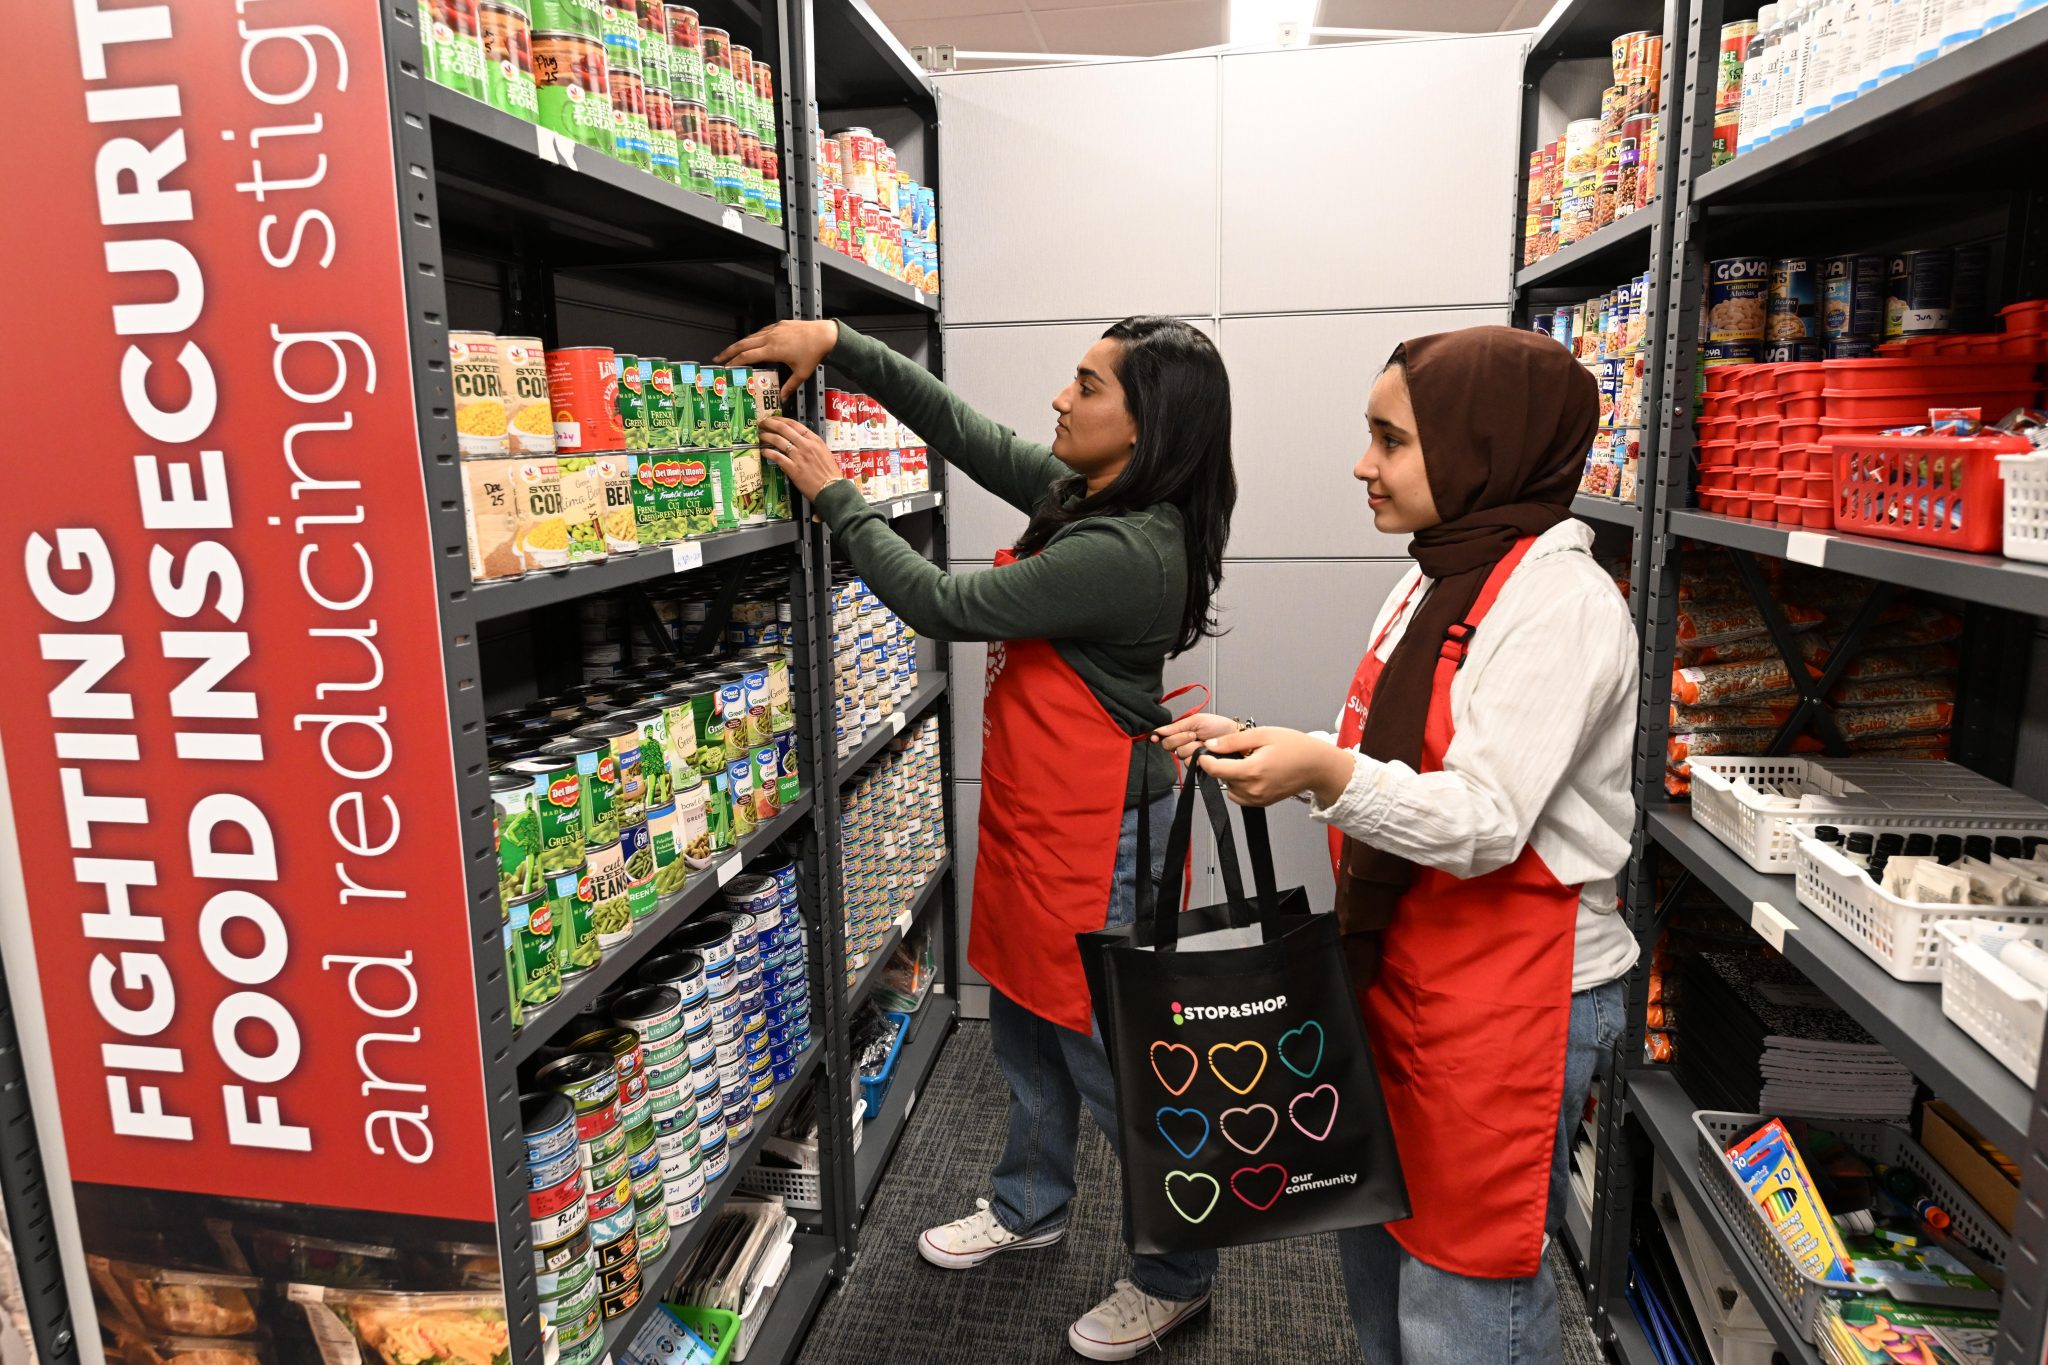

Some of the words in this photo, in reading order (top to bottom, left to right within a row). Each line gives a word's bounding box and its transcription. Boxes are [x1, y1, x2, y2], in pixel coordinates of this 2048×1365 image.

[1795, 80, 1804, 106] hand
[1717, 261, 1767, 280] GOYA
[655, 469, 666, 477] Del
[686, 468, 704, 477] Monte
[491, 494, 505, 507] 25
[667, 501, 681, 511] CUT
[686, 500, 701, 509] CUT
[267, 323, 407, 905] reducing
[752, 695, 768, 704] Green
[1847, 719, 1888, 734] Sarita
[552, 788, 564, 799] Del
[543, 809, 562, 817] MADE
[566, 822, 580, 834] CUT
[25, 528, 194, 1141] FIGHTING
[549, 836, 575, 848] GREEN
[603, 856, 623, 874] cut
[188, 793, 312, 1151] FOOD
[1183, 995, 1286, 1020] STOP&SHOP
[648, 1013, 671, 1026] BUMBLE
[650, 1025, 668, 1036] LIGHT
[651, 1038, 674, 1050] BUMBLE
[322, 949, 434, 1164] and
[653, 1049, 672, 1061] LIGHT
[663, 1069, 680, 1081] LIGHT
[651, 1087, 674, 1098] BUMBLE
[652, 1097, 672, 1108] LIGHT
[624, 1114, 642, 1127] LIGHT
[1735, 1157, 1747, 1170] 10
[1291, 1172, 1313, 1184] our
[1774, 1167, 1791, 1185] 10
[1285, 1172, 1358, 1195] community
[619, 1184, 629, 1196] FEB
[1893, 1312, 1914, 1321] Pad
